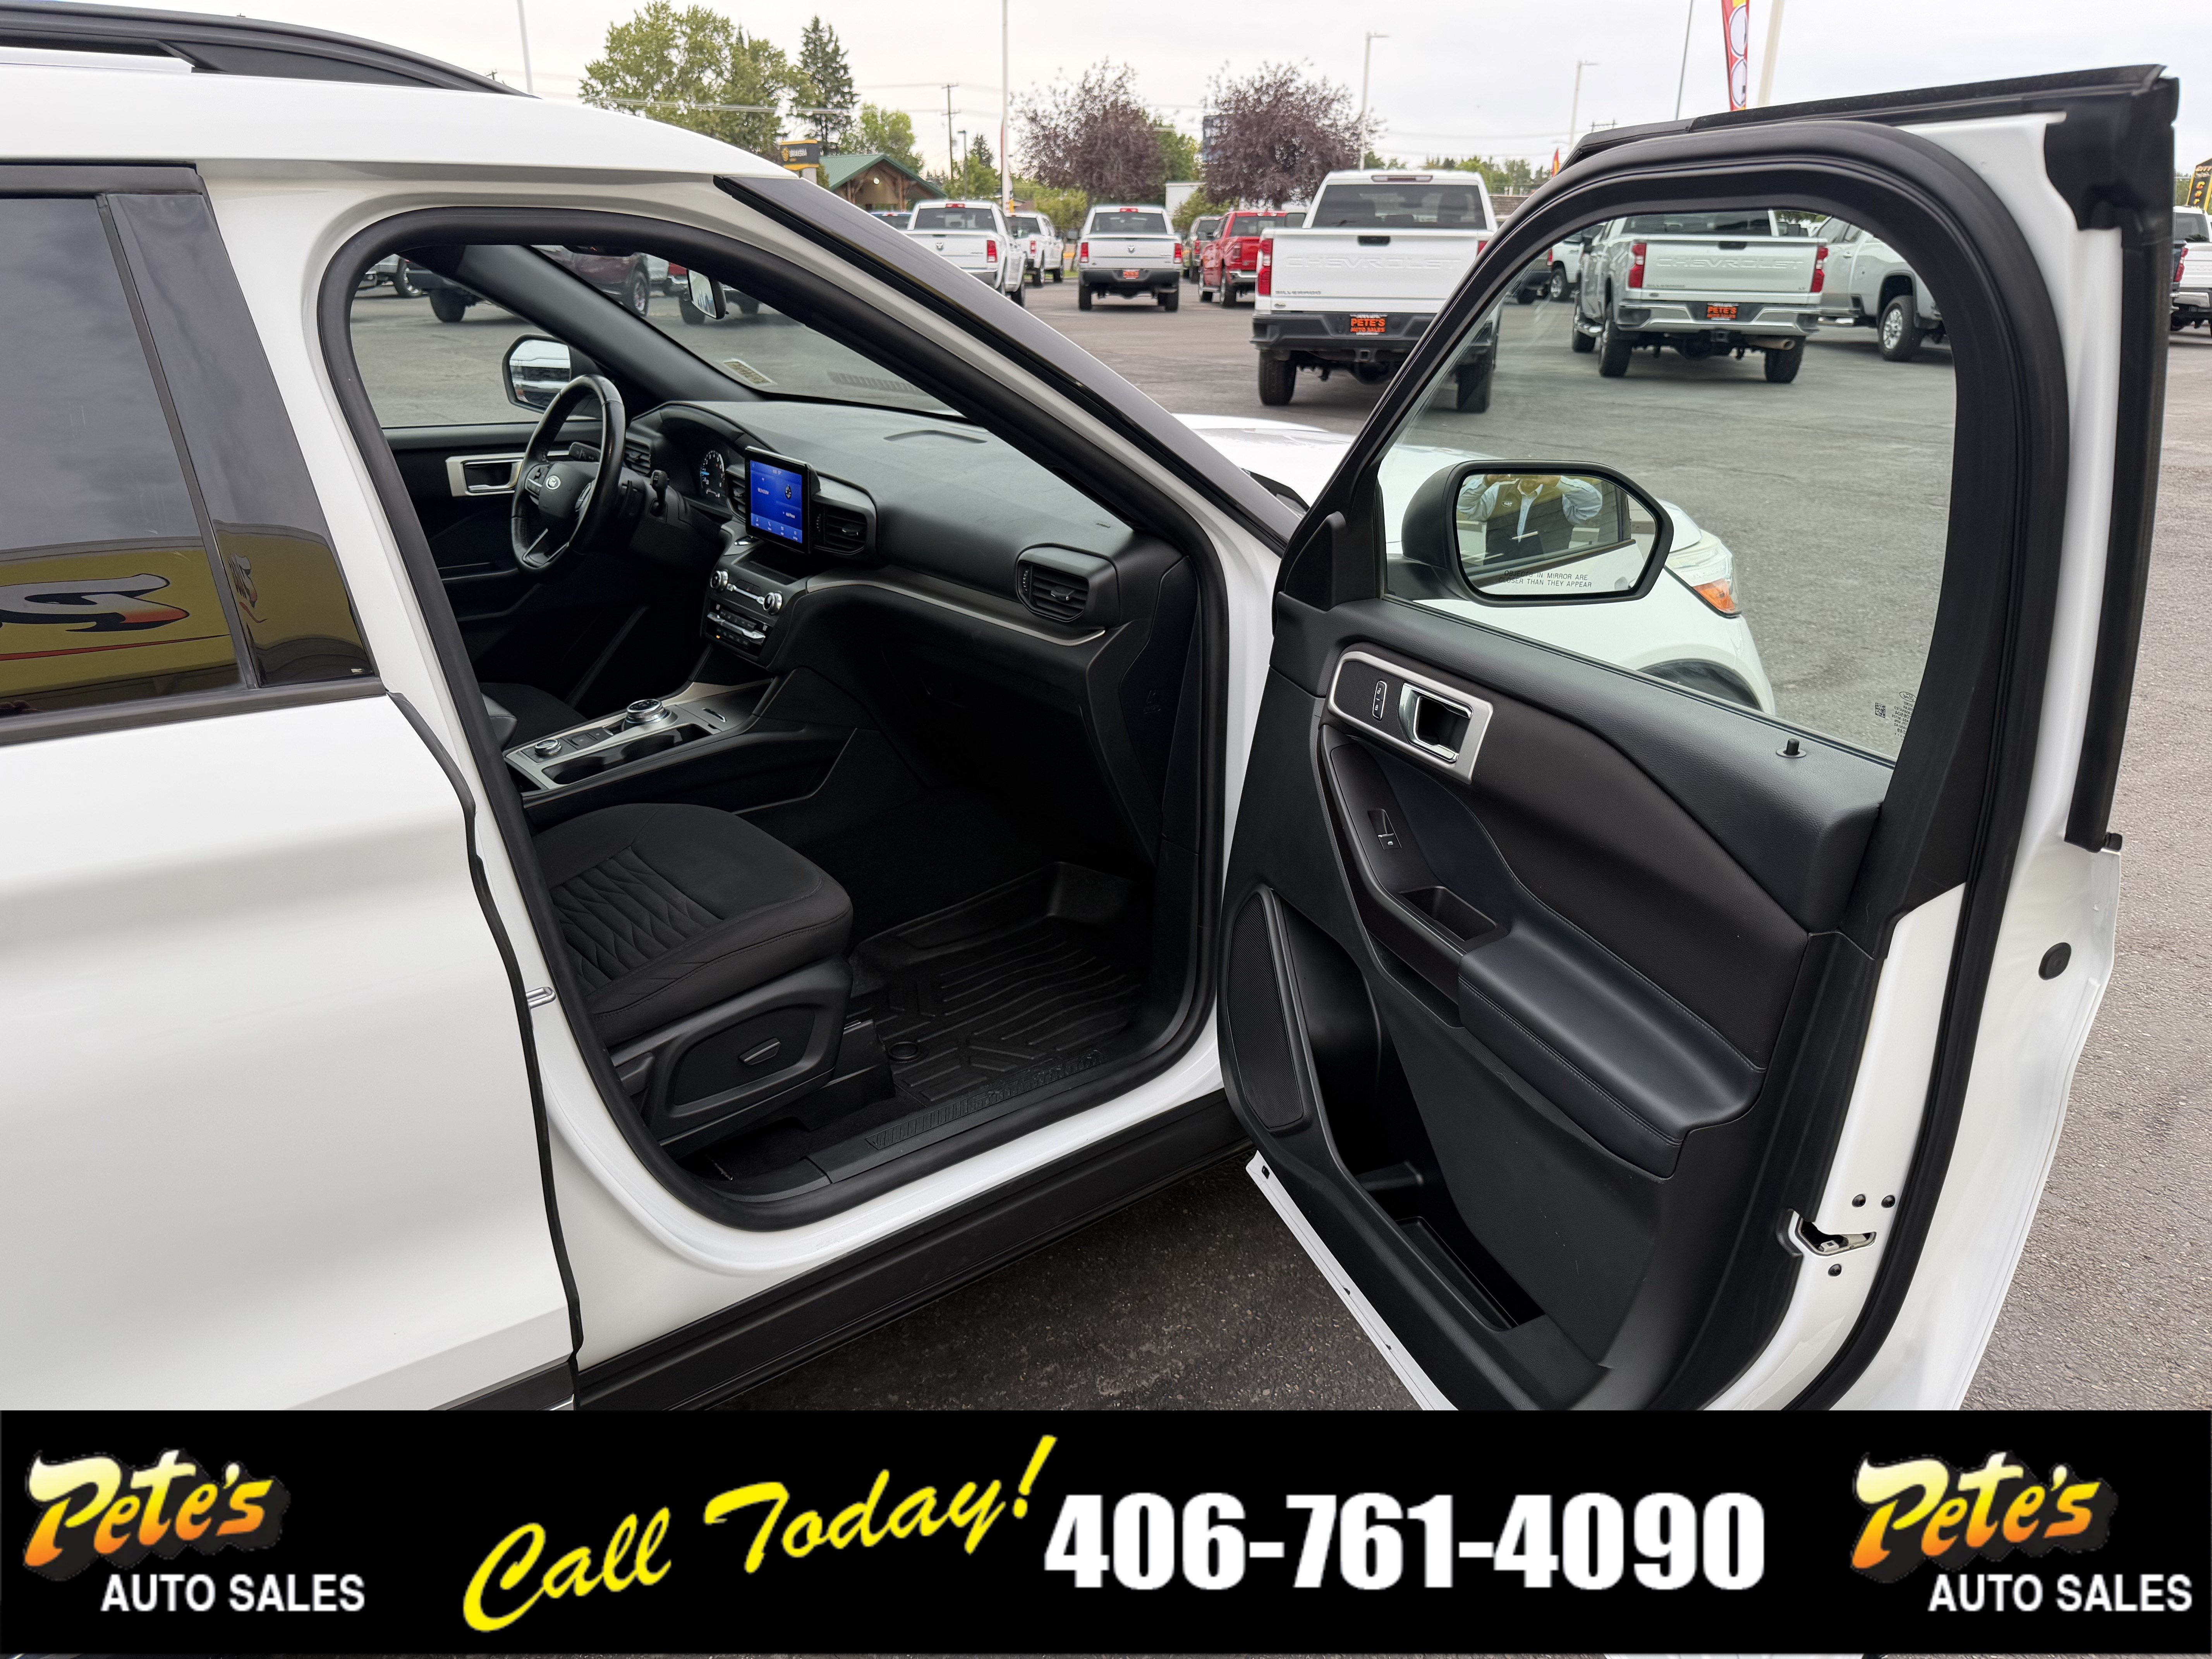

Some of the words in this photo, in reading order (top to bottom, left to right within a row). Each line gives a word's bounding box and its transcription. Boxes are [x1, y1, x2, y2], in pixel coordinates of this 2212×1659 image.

[1285, 257, 1462, 269] CHEVROLET
[1656, 258, 1804, 269] CHEVROLET
[1707, 306, 1737, 314] PETE'S
[1350, 318, 1385, 326] PETE'S
